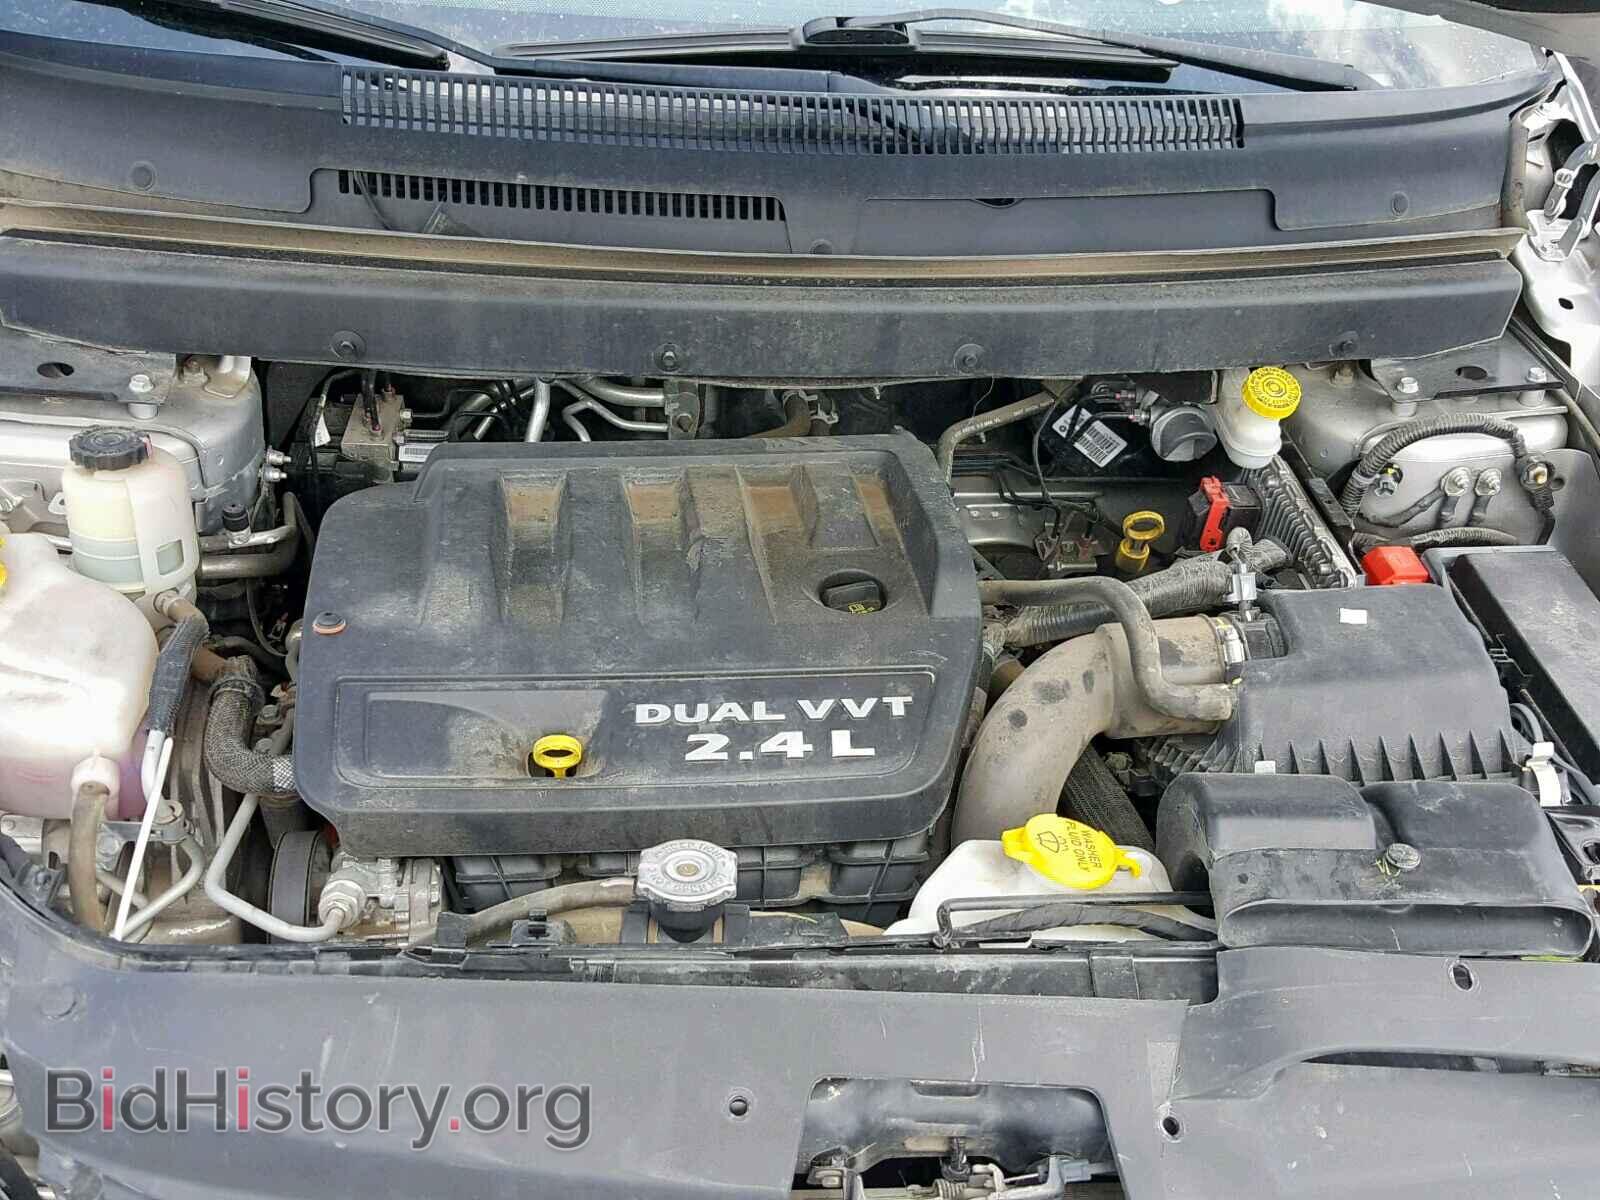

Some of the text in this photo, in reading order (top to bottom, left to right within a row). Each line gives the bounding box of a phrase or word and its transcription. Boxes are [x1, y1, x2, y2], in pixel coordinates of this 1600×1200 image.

[634, 696, 913, 724] DUAL VVT
[1065, 821, 1091, 873] FLUID ONLY
[1082, 830, 1102, 869] WASHER
